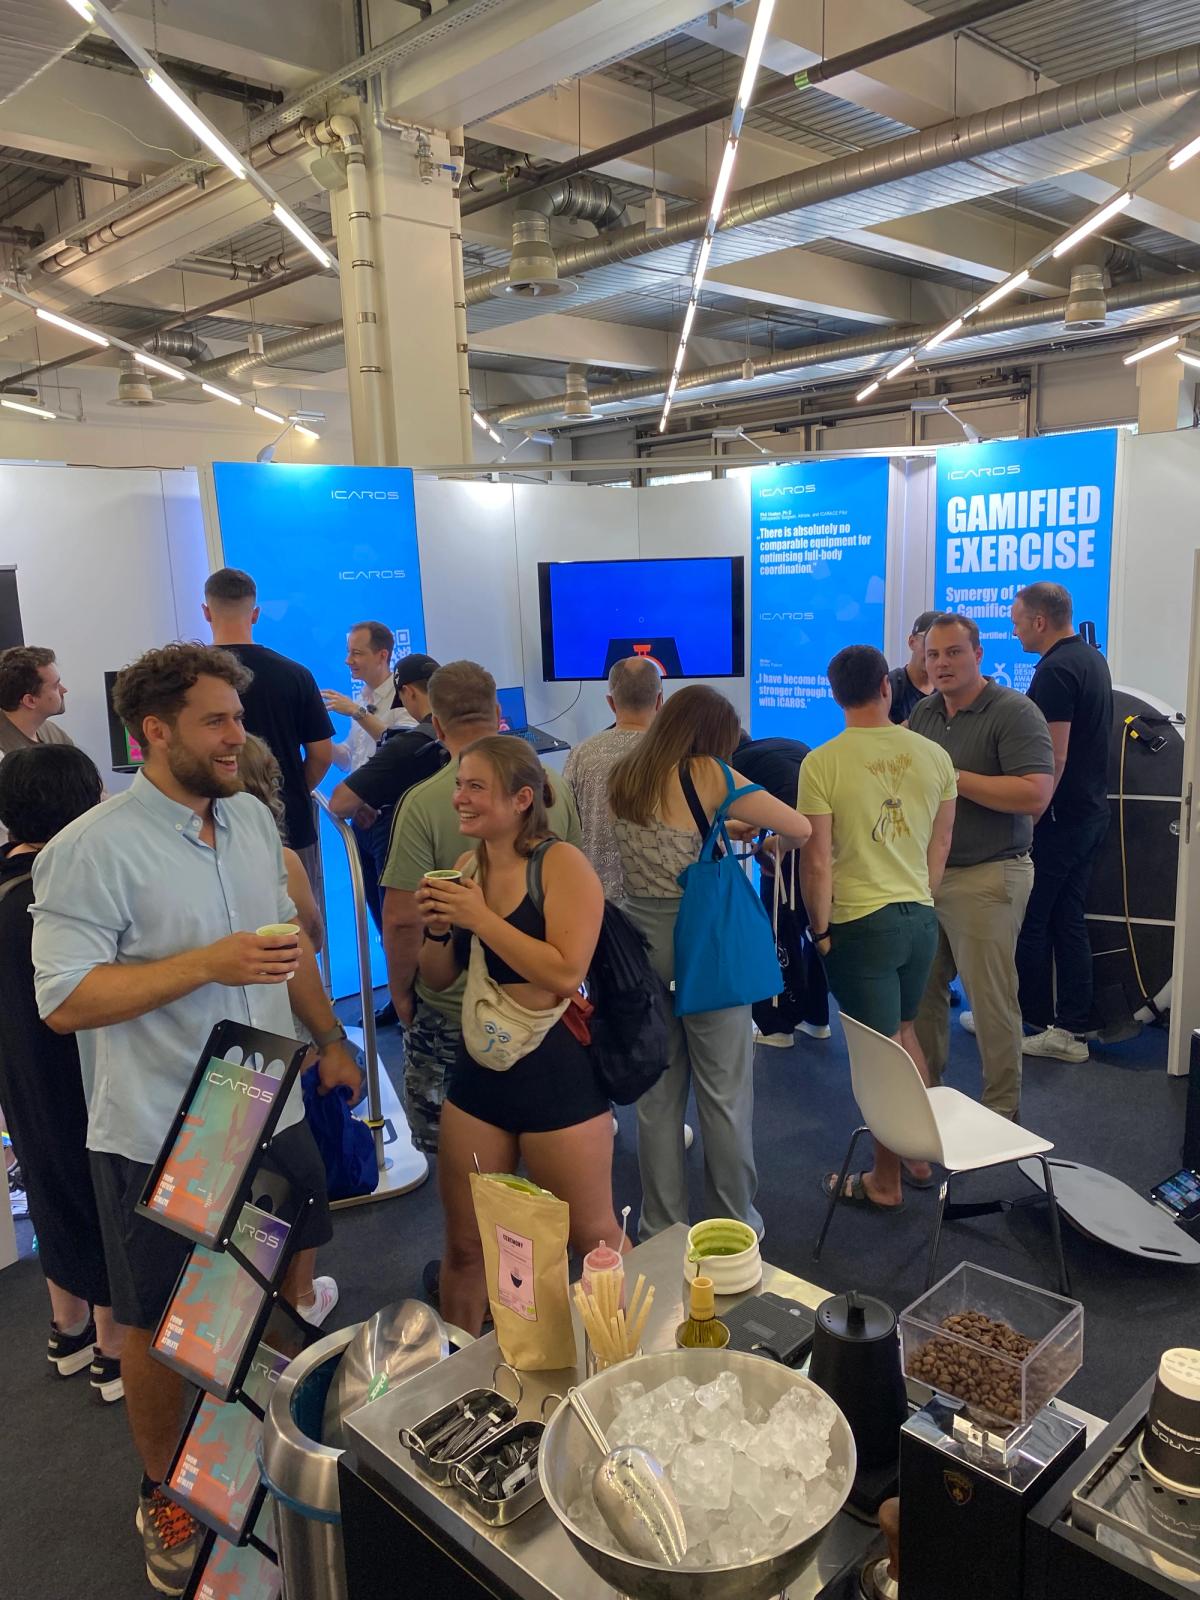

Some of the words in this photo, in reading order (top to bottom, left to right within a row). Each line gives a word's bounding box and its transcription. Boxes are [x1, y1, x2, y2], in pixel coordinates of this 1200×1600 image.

[947, 464, 1021, 481] ICAROS
[331, 490, 399, 500] ICAROS
[759, 484, 816, 497] ICAROS
[946, 485, 1101, 534] GAMIFIED
[784, 526, 792, 537] is
[793, 523, 838, 537] absolutely
[839, 523, 851, 534] no
[760, 538, 809, 551] comparable
[809, 536, 857, 549] equipment
[858, 534, 872, 546] for
[760, 551, 803, 564] optimising
[804, 549, 843, 561] full-body
[946, 529, 1096, 574] EXERCISE
[339, 569, 405, 580] ICAROS
[946, 586, 998, 603] Synergy
[1001, 584, 1014, 600] of
[759, 612, 814, 620] ICAROS
[957, 602, 1013, 619] Gamifica
[763, 673, 782, 684] have
[783, 674, 816, 685] become
[817, 674, 831, 686] fas
[759, 685, 793, 697] stronger
[794, 686, 826, 699] through
[759, 696, 776, 707] with
[205, 1071, 274, 1104] ICAROS
[237, 1220, 280, 1249] AROS
